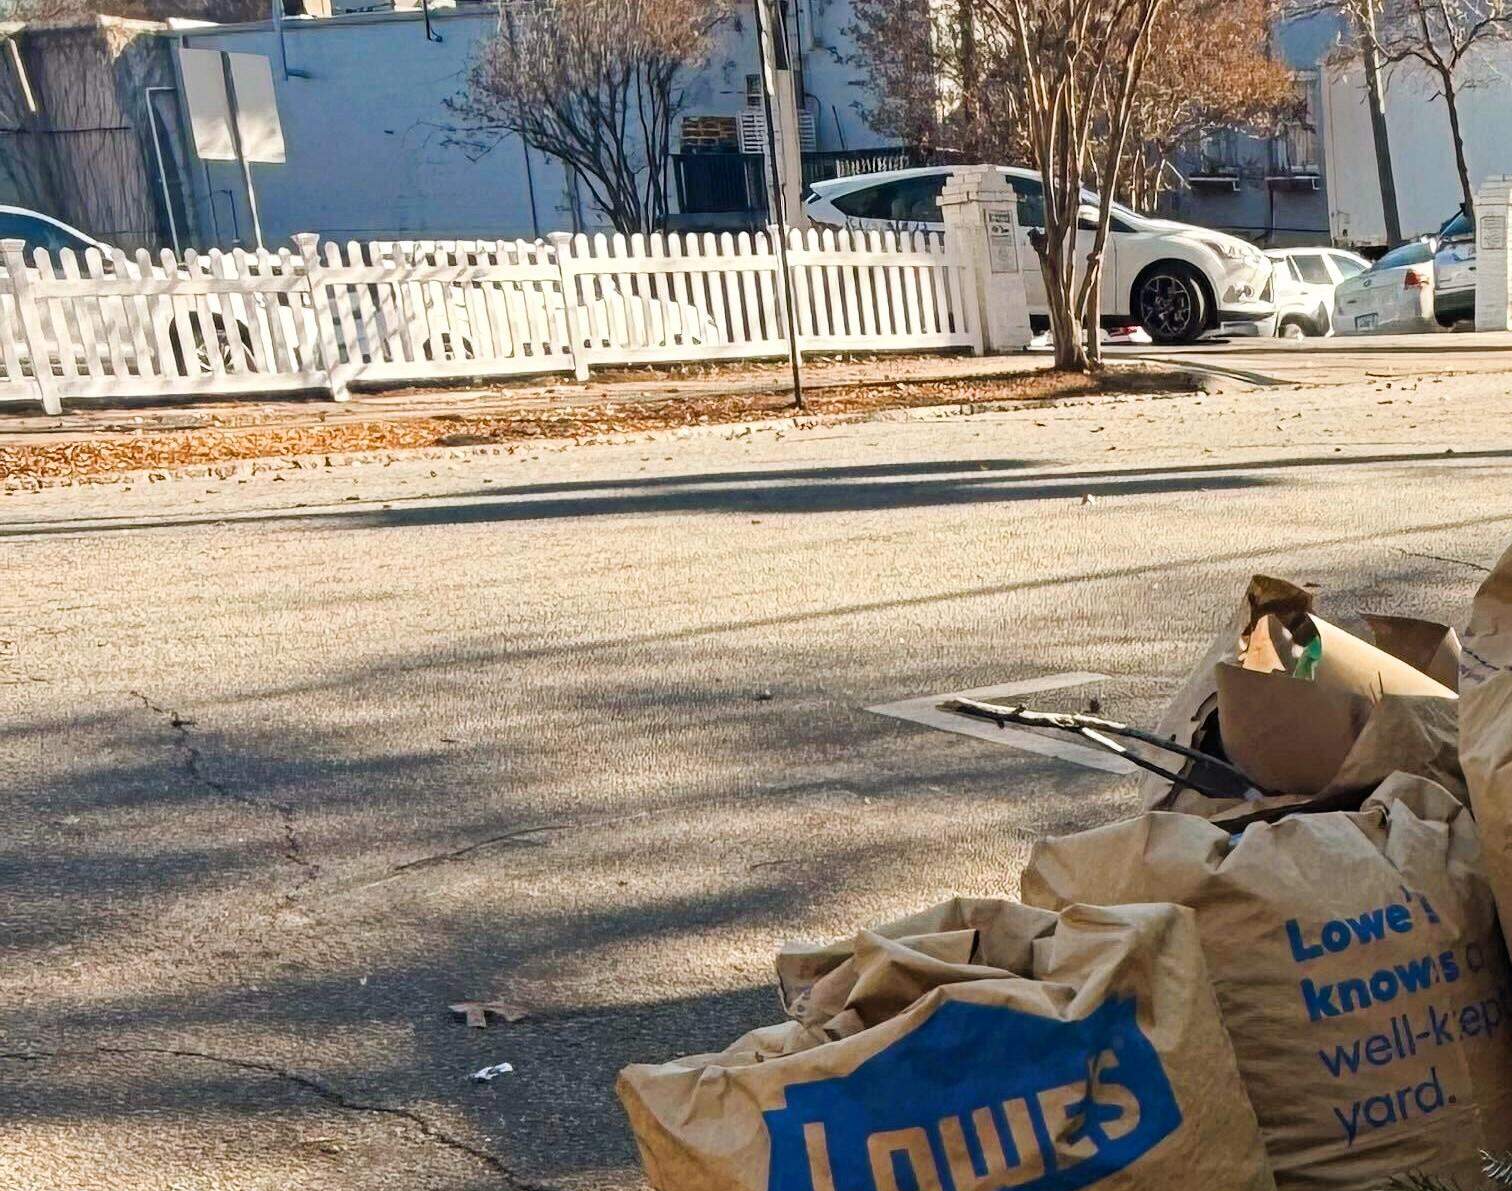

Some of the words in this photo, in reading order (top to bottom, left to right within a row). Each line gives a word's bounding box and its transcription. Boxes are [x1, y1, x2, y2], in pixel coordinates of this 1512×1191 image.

[1300, 951, 1460, 1022] knows
[1319, 1000, 1502, 1078] well-kep
[1333, 1066, 1457, 1146] yard.
